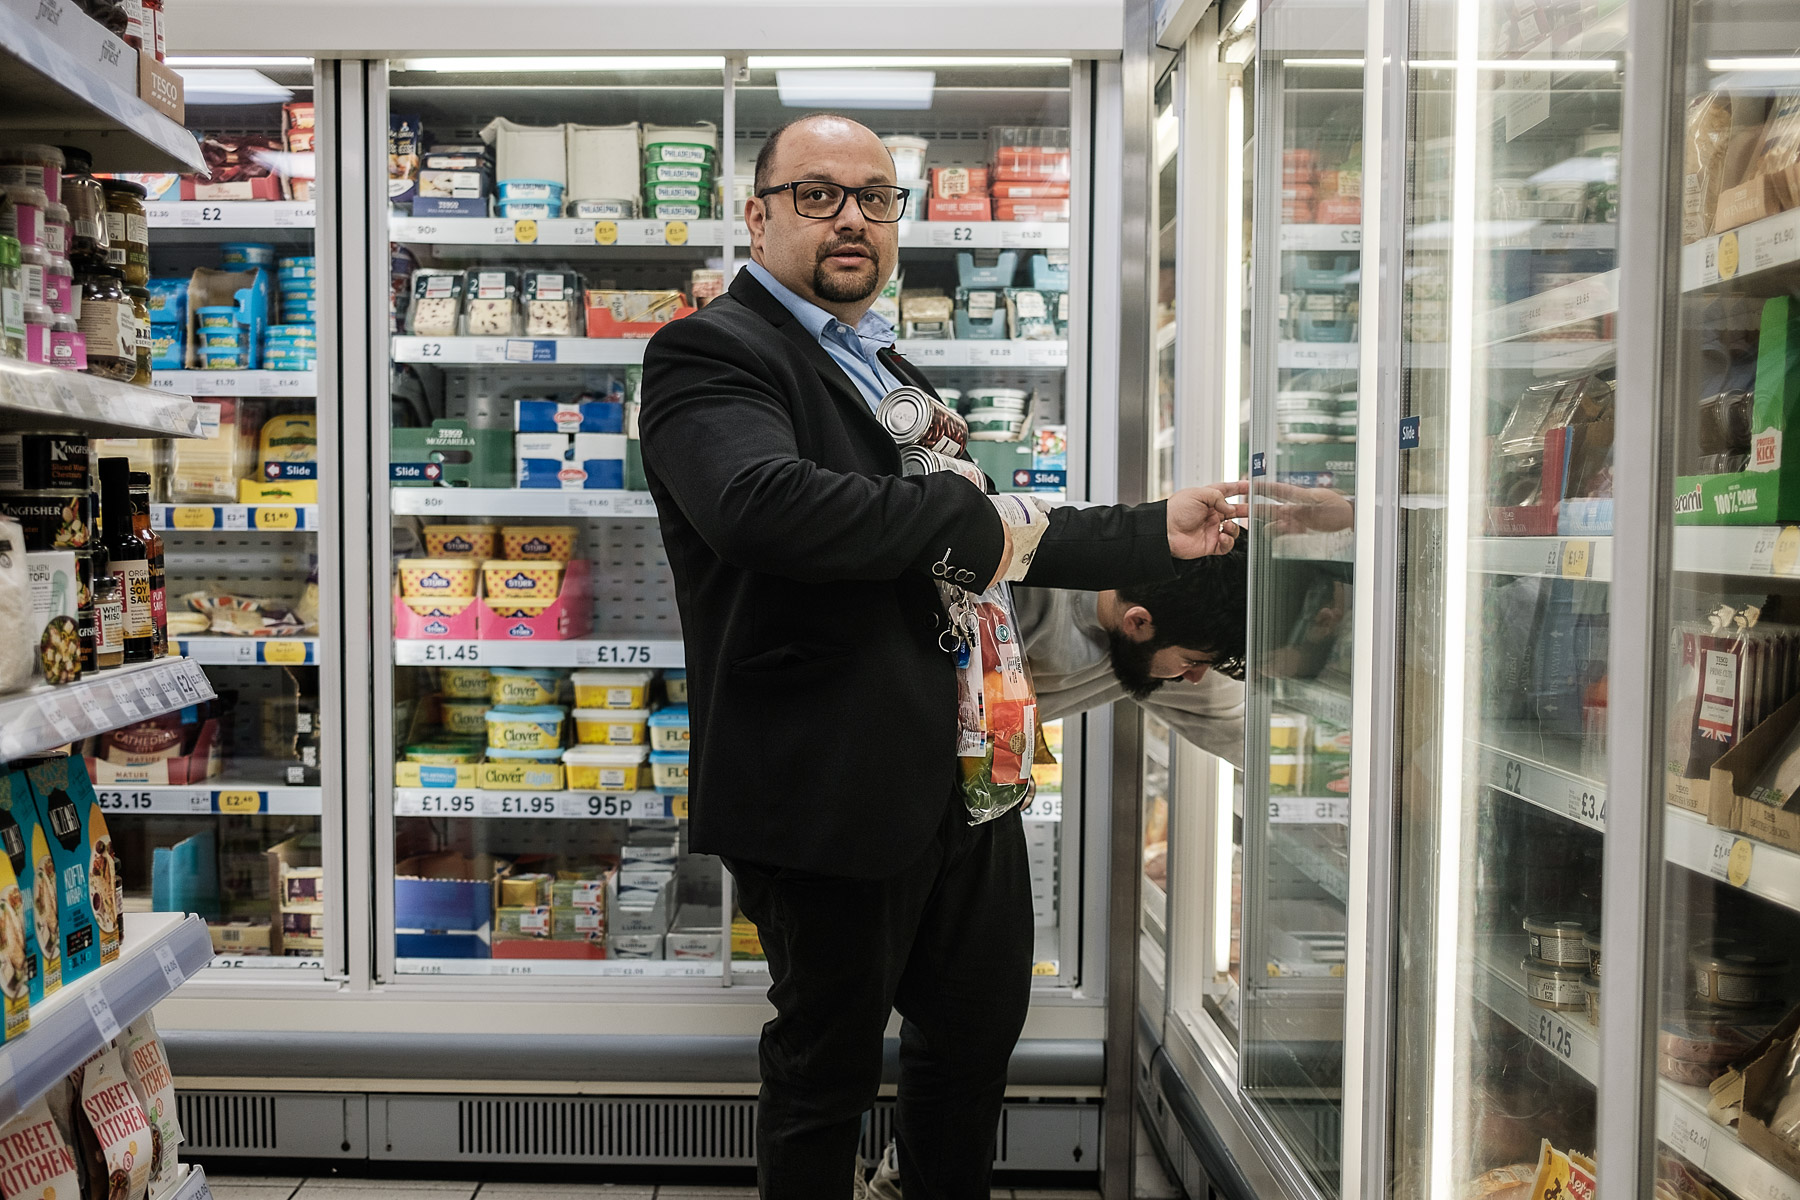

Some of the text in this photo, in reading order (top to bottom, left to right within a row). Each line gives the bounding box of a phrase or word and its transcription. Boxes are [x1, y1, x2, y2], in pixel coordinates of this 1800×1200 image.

[151, 72, 178, 101] TESCO
[202, 207, 222, 221] £2
[953, 227, 972, 241] £2
[422, 343, 441, 357] £2
[1402, 426, 1415, 441] Slide
[1756, 444, 1776, 460] KICK
[286, 465, 311, 476] Slide
[395, 467, 420, 477] Slide
[1034, 473, 1060, 483] Slide
[1713, 488, 1758, 515] 100% PORK
[1547, 551, 1557, 565] £2
[130, 586, 147, 595] SOY
[104, 614, 121, 622] MISO
[425, 645, 479, 661] £1.45
[597, 646, 650, 663] £1.75
[1715, 655, 1729, 664] TESCO
[176, 675, 194, 694] £2
[453, 676, 489, 688] Clover
[503, 683, 538, 697] Clover
[114, 730, 178, 747] CATHEDRAL
[504, 729, 541, 742] Clover
[115, 771, 149, 779] MATURE
[486, 768, 524, 783] Clover
[1505, 760, 1521, 794] £2
[100, 792, 152, 809] £3.15
[422, 796, 475, 812] £1.95
[502, 796, 555, 813] £1.95
[588, 796, 632, 816] 95p
[1540, 1015, 1572, 1059] £1.25
[85, 1081, 134, 1123] STREET
[94, 1105, 150, 1151] KITCHEN
[0, 1146, 76, 1200] KITCHEN
